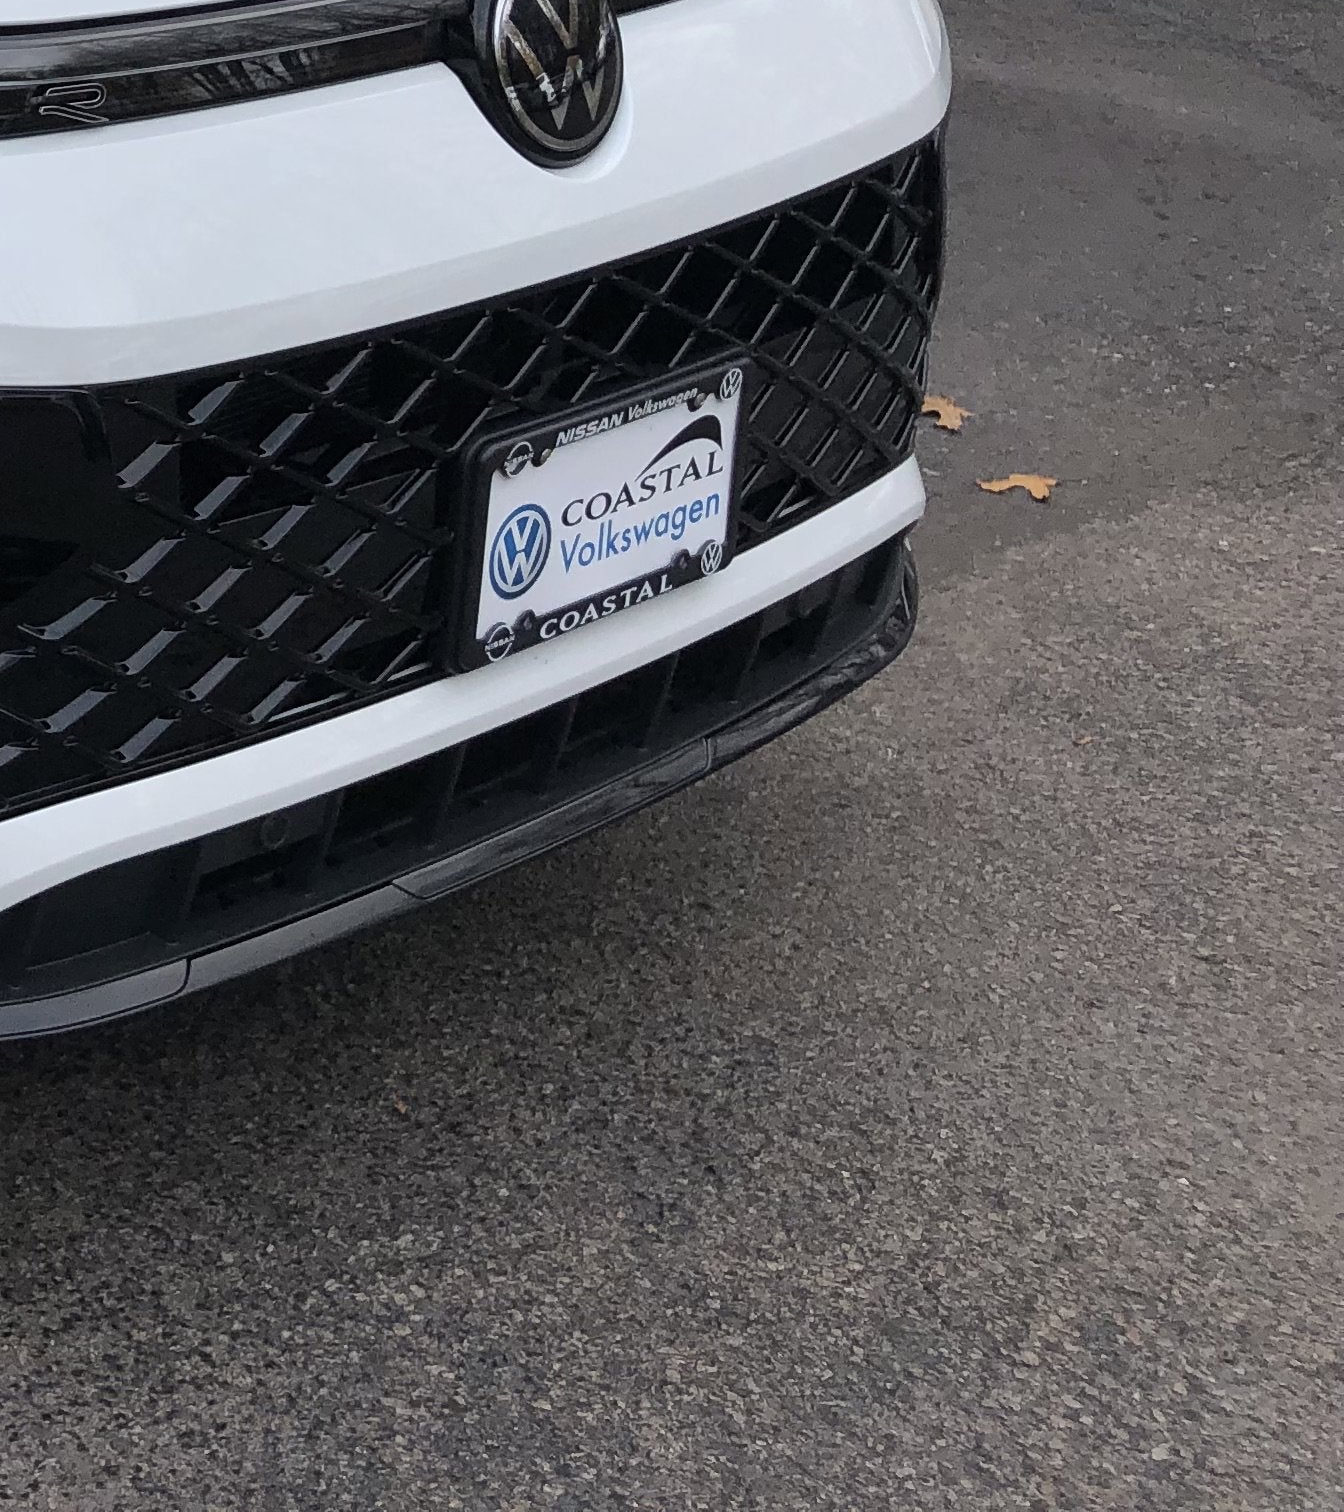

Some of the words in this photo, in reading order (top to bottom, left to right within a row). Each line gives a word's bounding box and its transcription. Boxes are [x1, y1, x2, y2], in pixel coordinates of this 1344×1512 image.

[556, 412, 624, 447] NISSAN
[628, 387, 698, 421] Volkswagen
[561, 450, 723, 527] COASTAL
[560, 493, 720, 574] Volkswagen
[540, 574, 673, 639] COASTAL
